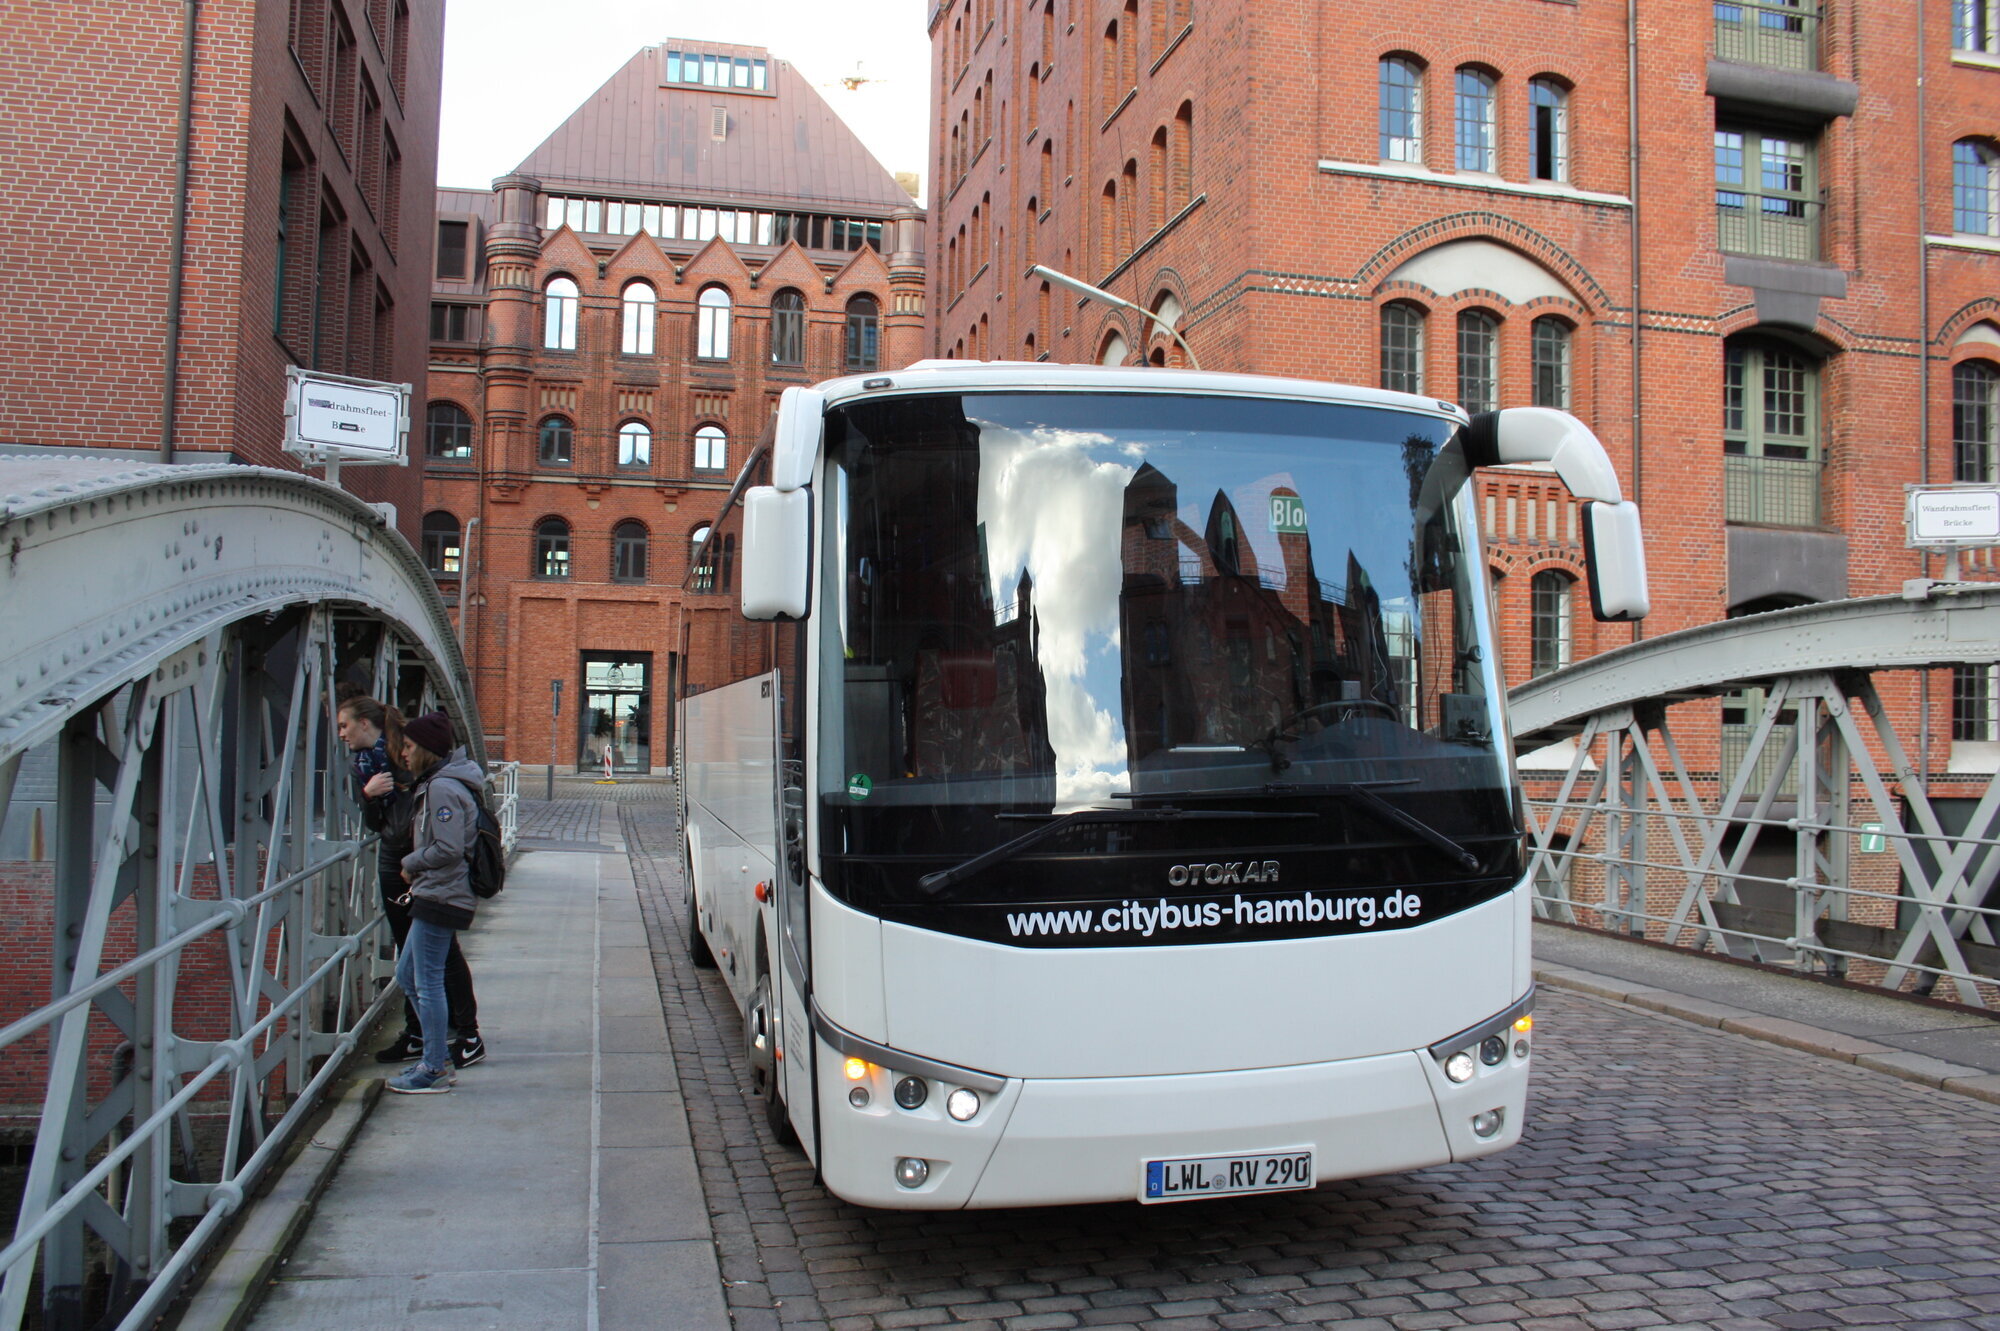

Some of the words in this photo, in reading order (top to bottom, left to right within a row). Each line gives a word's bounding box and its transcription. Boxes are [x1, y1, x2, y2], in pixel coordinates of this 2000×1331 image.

[308, 398, 392, 417] drahmsfleet-
[1943, 519, 1973, 527] Brücke
[1866, 826, 1880, 850] 7
[1168, 860, 1281, 887] OTOKAR
[1007, 888, 1421, 937] www.citybus-hamburg.de
[1165, 1163, 1210, 1191] LWL
[1230, 1160, 1259, 1187] RV
[1265, 1156, 1310, 1185] 290
